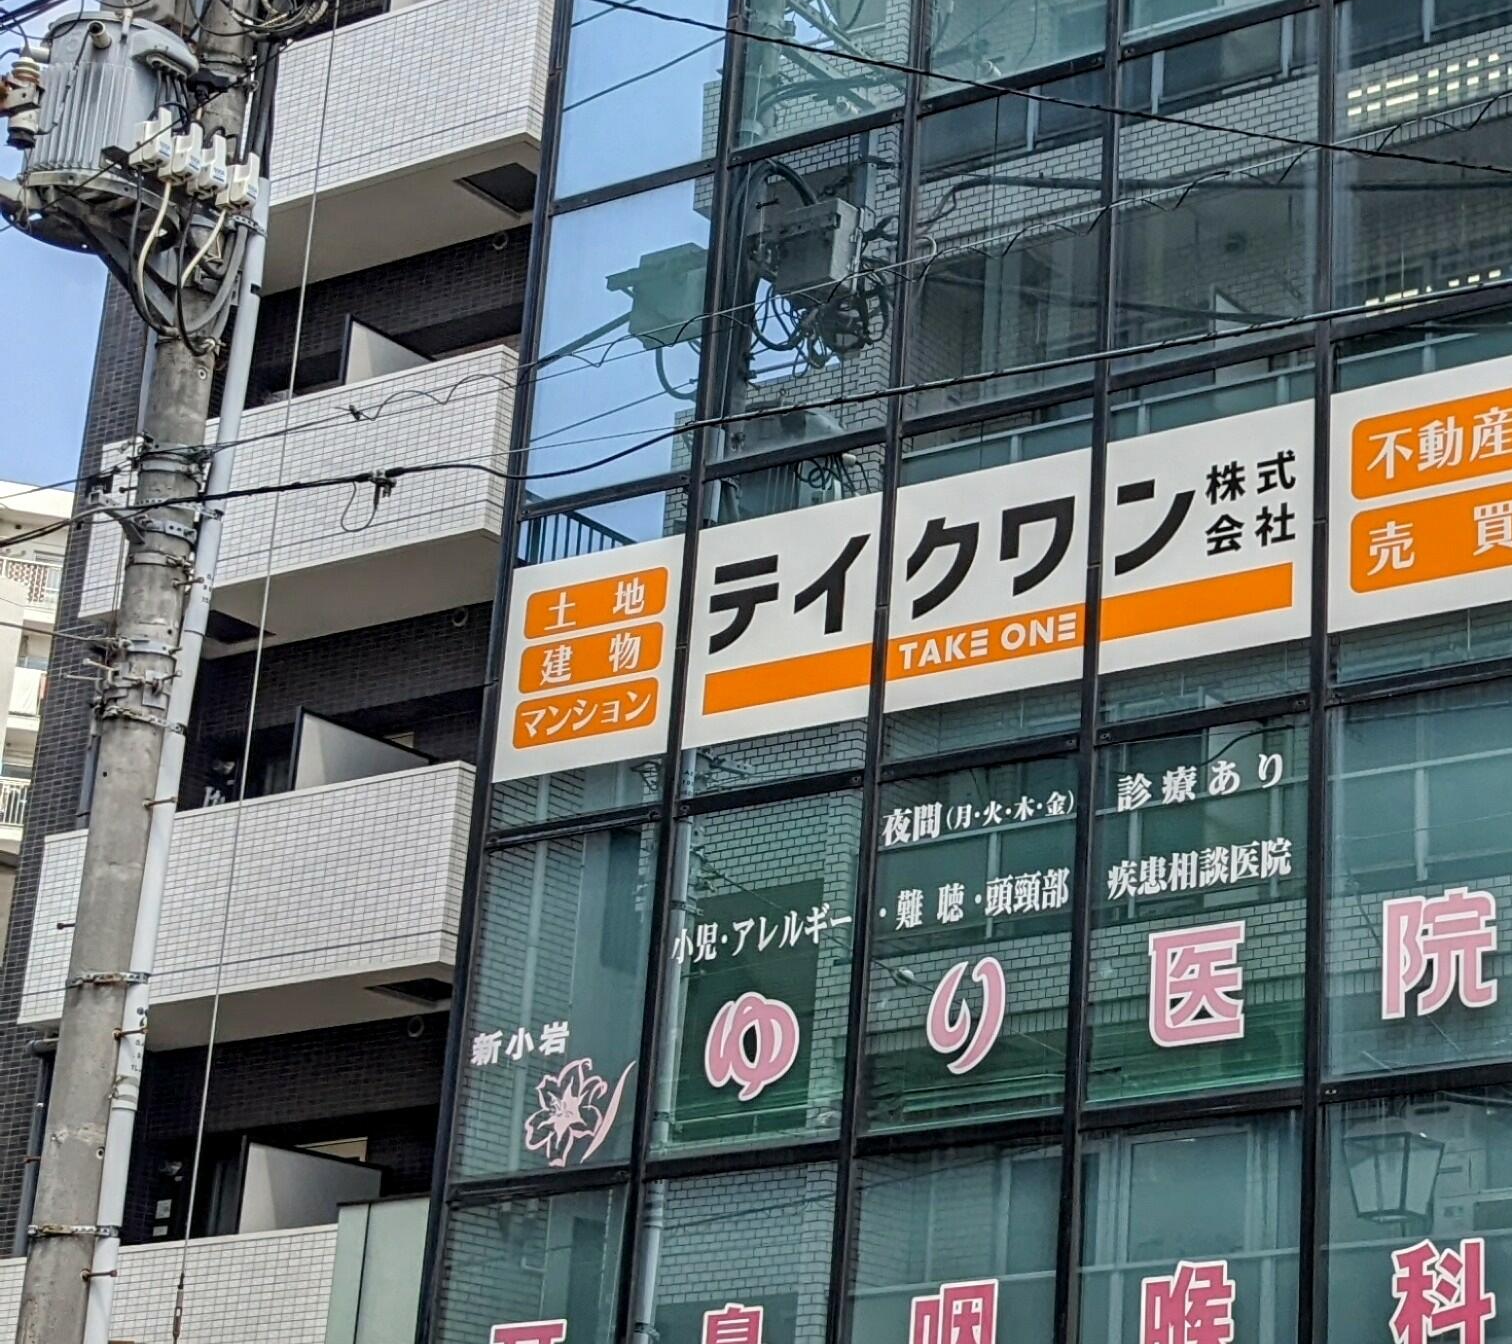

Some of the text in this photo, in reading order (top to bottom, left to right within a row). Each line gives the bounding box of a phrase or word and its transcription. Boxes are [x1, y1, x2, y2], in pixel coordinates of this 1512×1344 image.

[1206, 450, 1297, 505] 株式
[1205, 502, 1297, 557] 会社
[709, 479, 1196, 655] テイクワン
[544, 577, 645, 631] 土地
[540, 632, 641, 686] 建物
[899, 611, 1077, 671] TAKE ONE
[521, 691, 651, 738] マンション
[1117, 753, 1283, 812] 診療あり
[1107, 837, 1292, 899] 疾患相談医院
[470, 1021, 570, 1066] 新小岩
